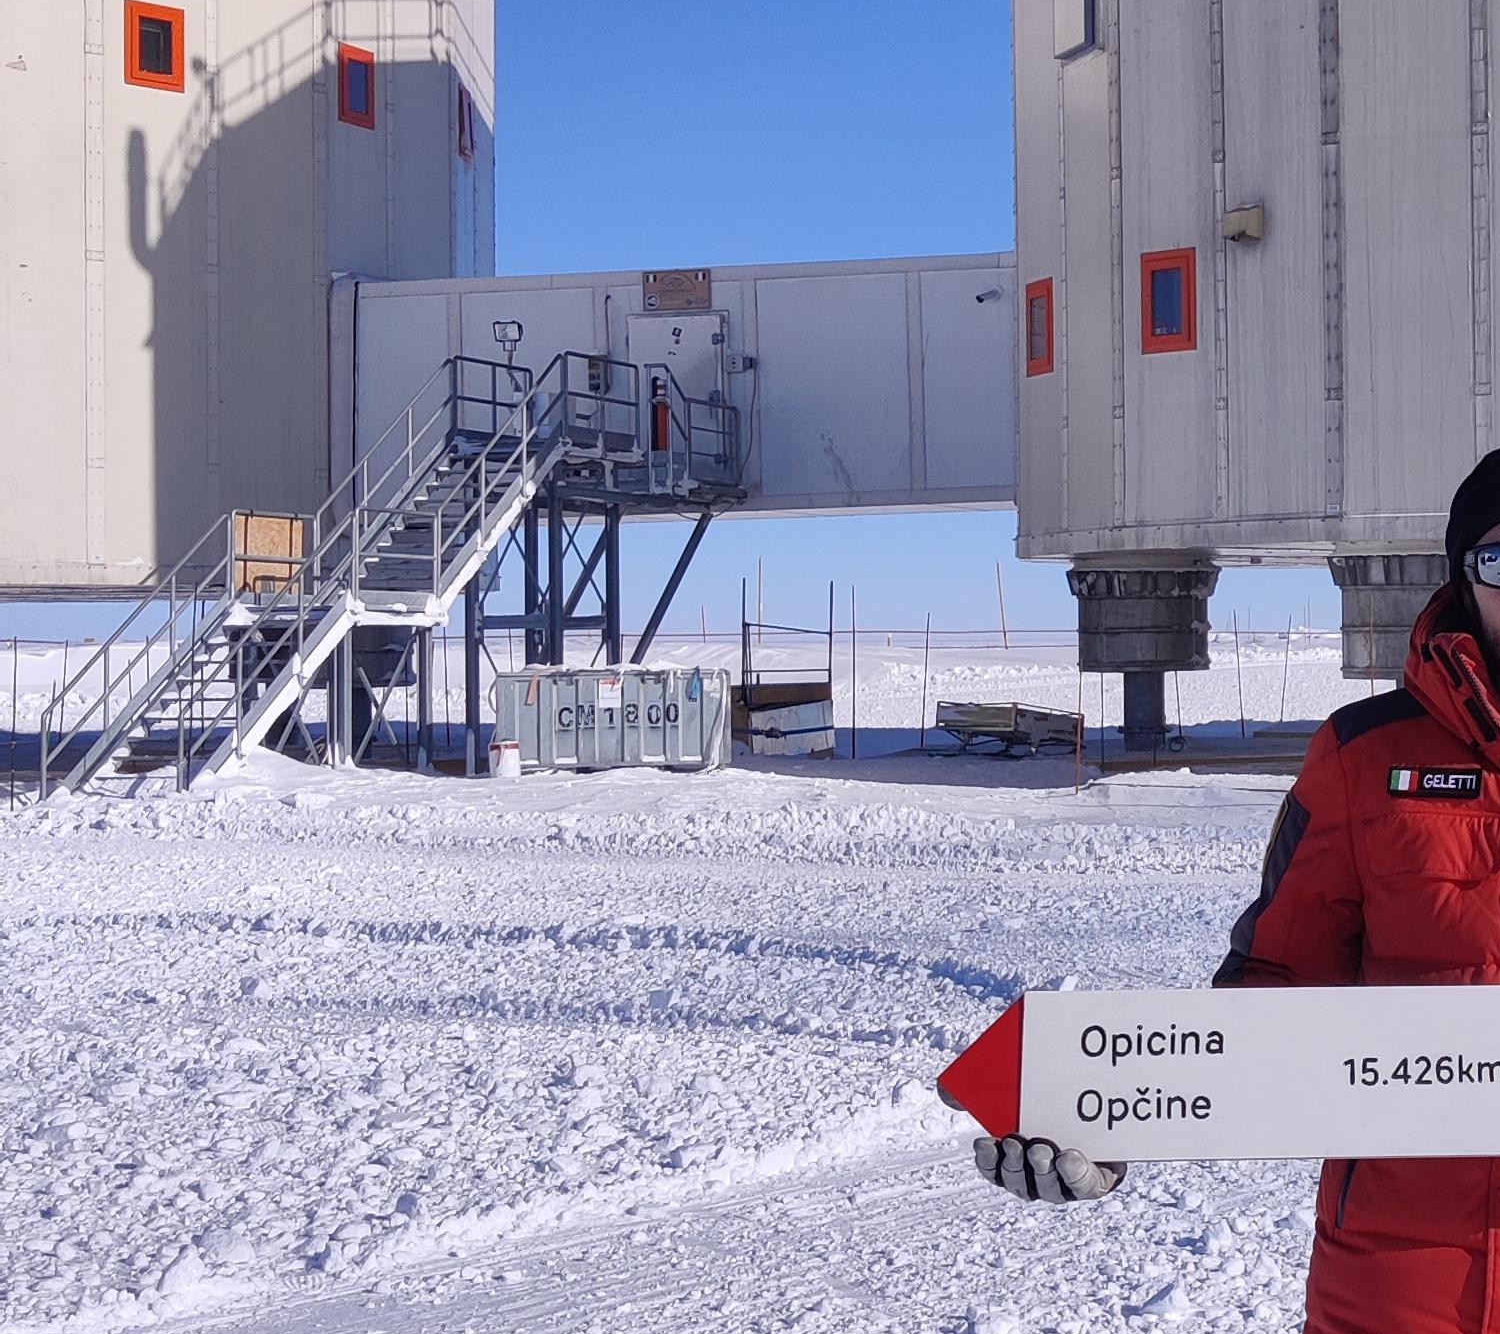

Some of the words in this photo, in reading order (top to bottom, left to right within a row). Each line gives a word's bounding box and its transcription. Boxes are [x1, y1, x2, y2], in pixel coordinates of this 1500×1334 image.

[1423, 773, 1476, 790] GELETTI
[1081, 1024, 1224, 1066] Opicina
[1077, 1087, 1212, 1130] Opčine
